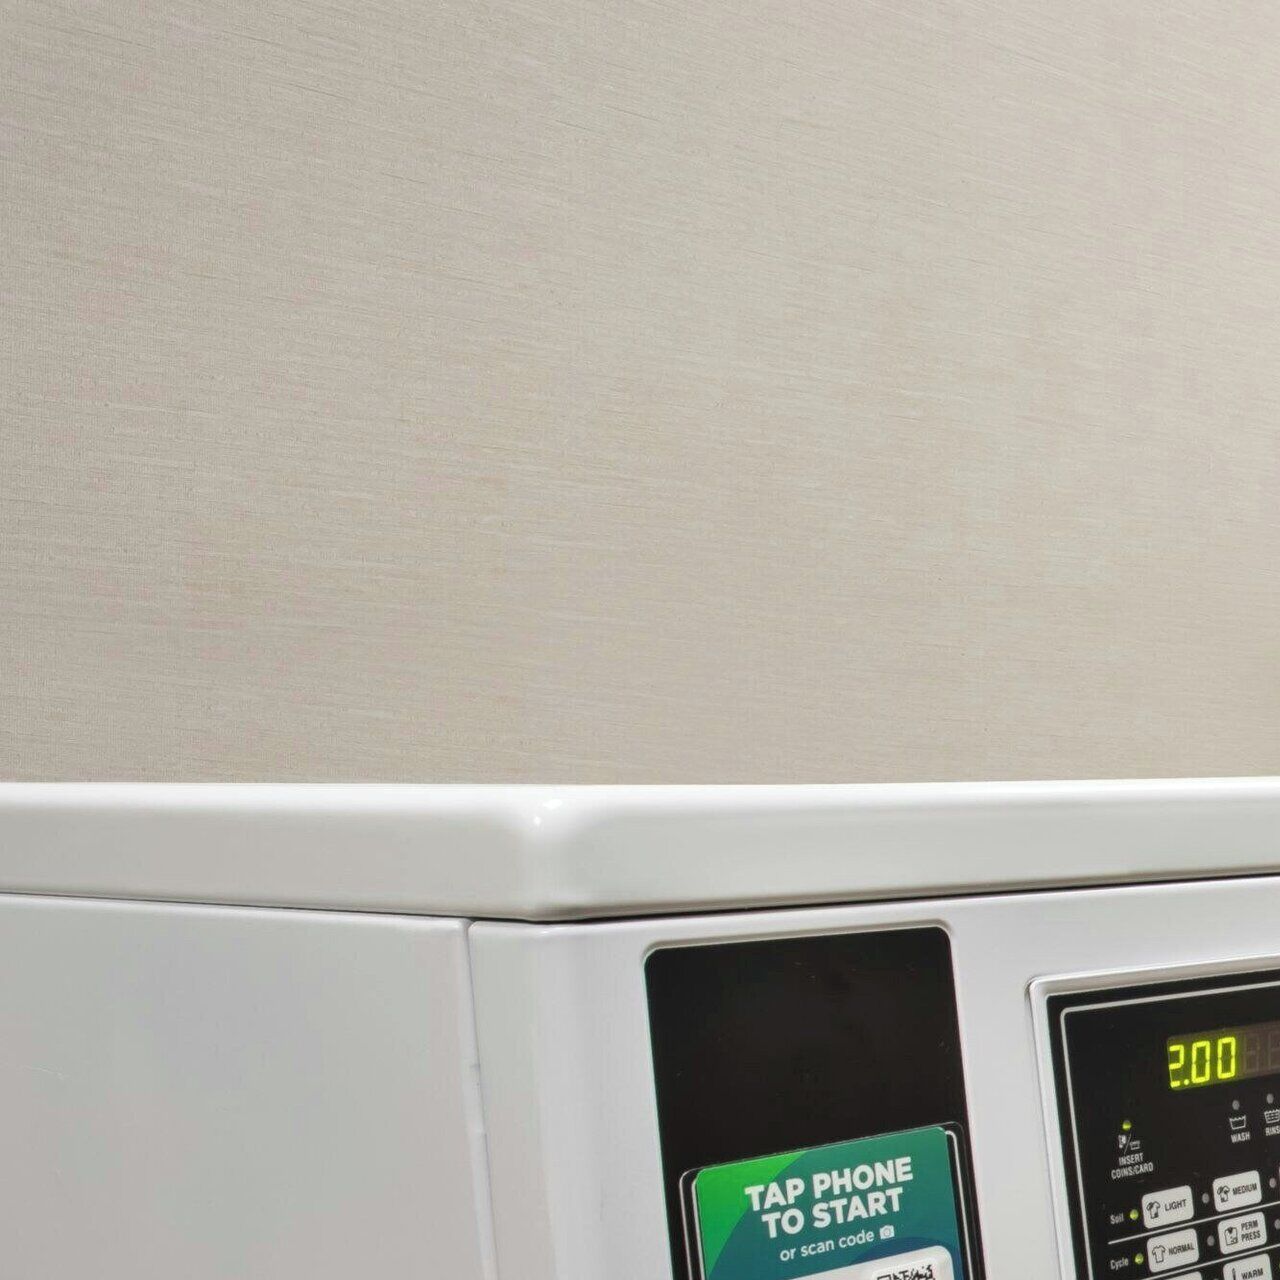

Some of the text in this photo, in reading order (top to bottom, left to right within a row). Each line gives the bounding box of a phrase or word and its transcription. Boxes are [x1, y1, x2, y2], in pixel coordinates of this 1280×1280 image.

[1168, 1036, 1236, 1087] 2.00
[1230, 1131, 1250, 1143] WASH
[1118, 1152, 1143, 1166] INSERT
[744, 1156, 912, 1211] TAP PHONE
[1232, 1182, 1258, 1195] MEDIUM
[1163, 1198, 1187, 1212] LIGHT
[761, 1187, 903, 1238] TO START
[1240, 1219, 1259, 1231] PERM
[1240, 1229, 1261, 1242] PRESS
[779, 1229, 874, 1261] or scan code
[1167, 1242, 1194, 1255] NORMAL
[1110, 1257, 1129, 1270] Cycle
[1240, 1267, 1264, 1280] WARM
